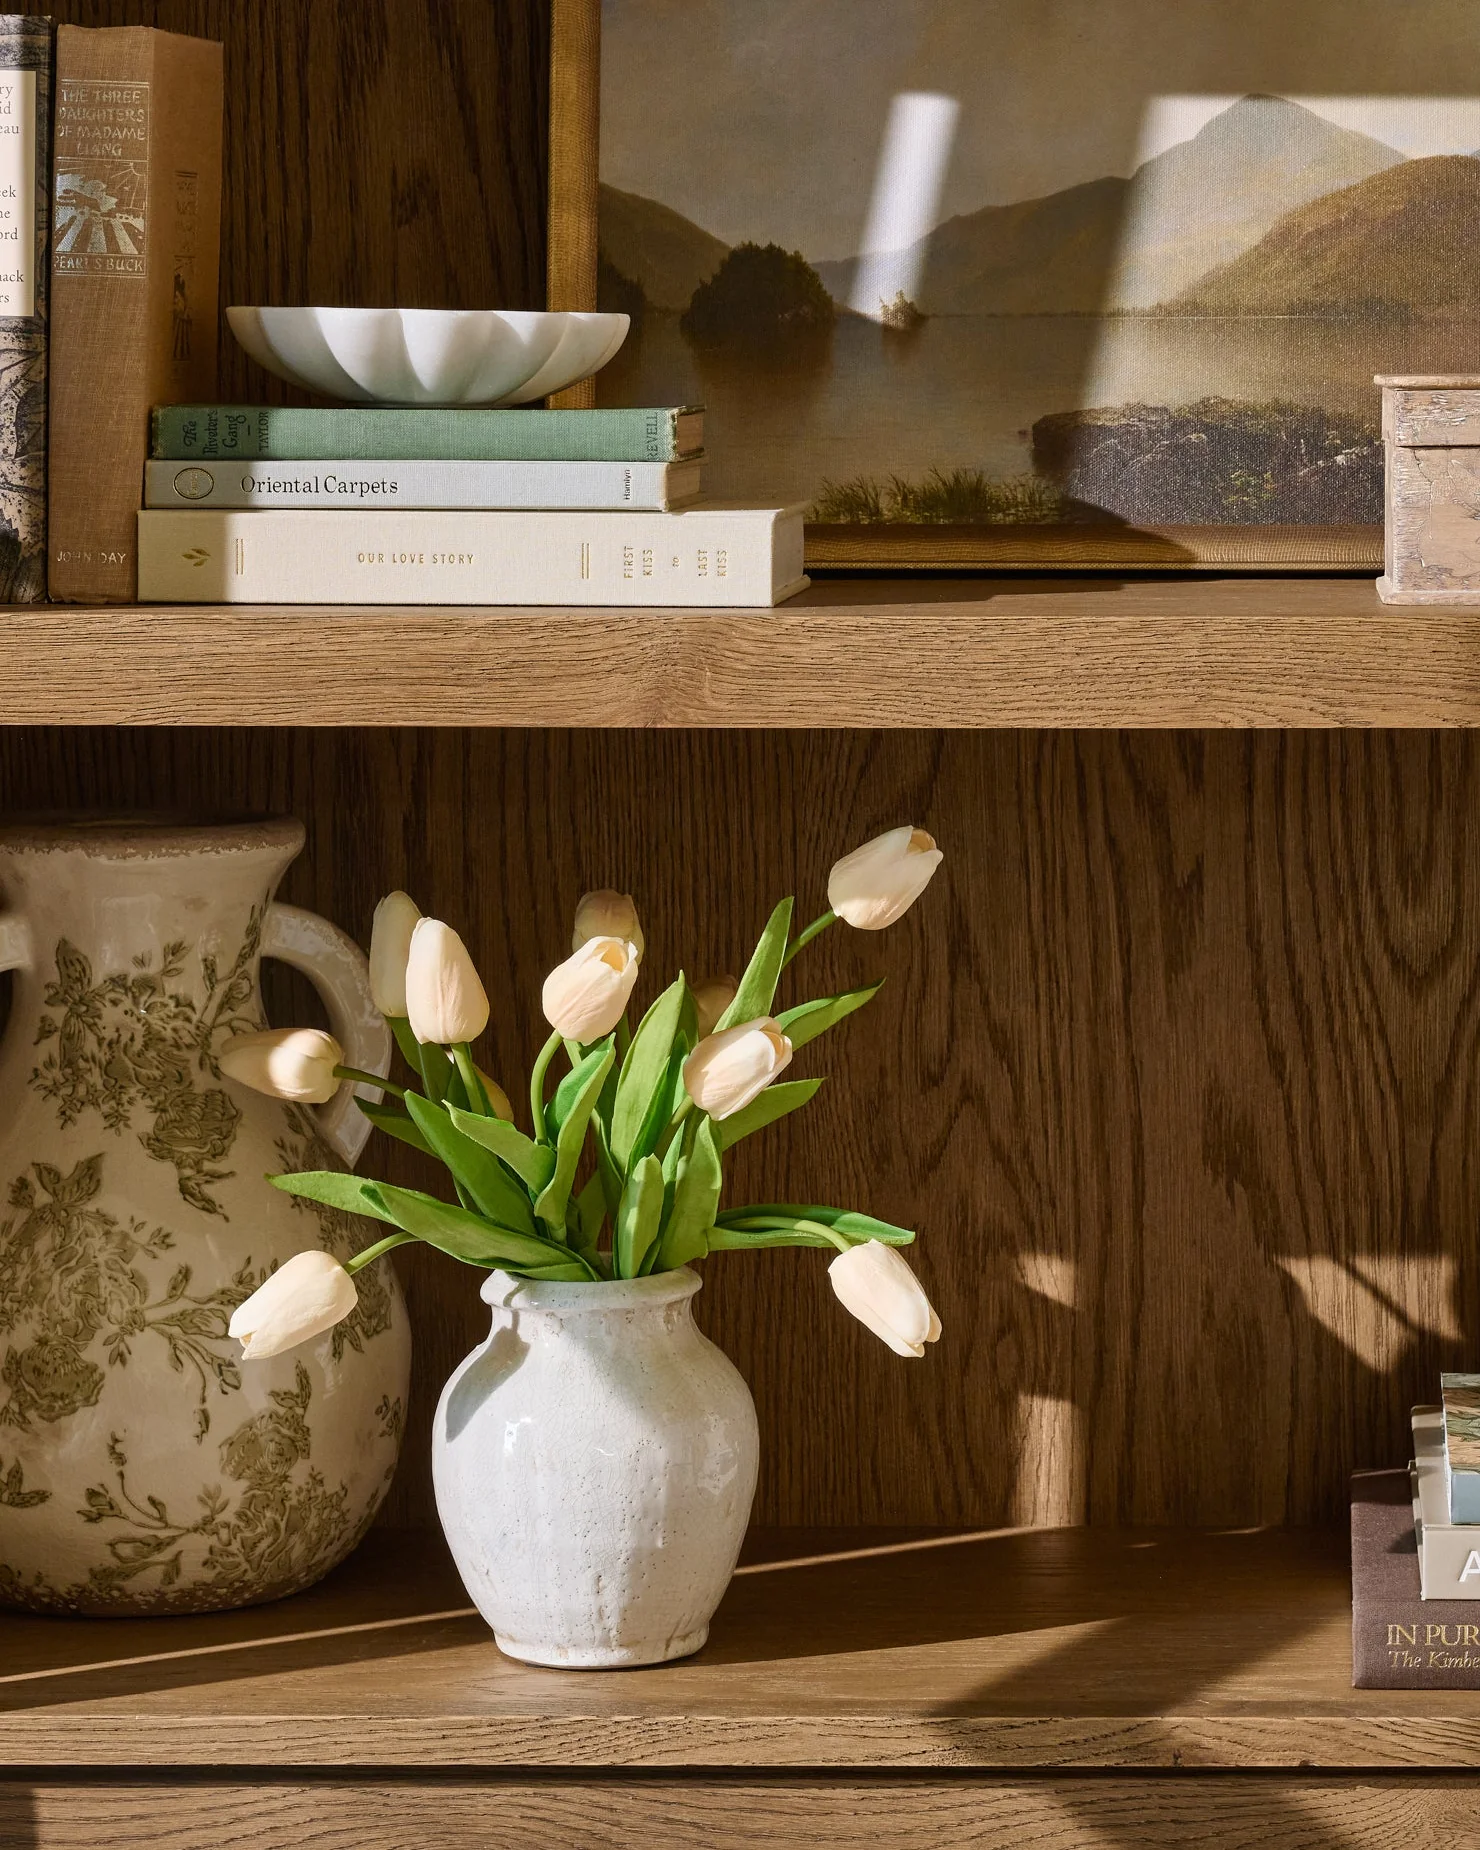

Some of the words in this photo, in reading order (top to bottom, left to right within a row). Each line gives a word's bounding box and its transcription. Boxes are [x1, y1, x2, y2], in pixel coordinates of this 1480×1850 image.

[62, 89, 87, 102] THE
[93, 90, 141, 104] THREE
[59, 107, 145, 122] DAUGHTERS
[77, 126, 146, 140] MADAME
[94, 258, 103, 270] S
[106, 259, 143, 272] BUCK
[182, 420, 198, 447] The
[222, 414, 247, 449] Gang
[258, 411, 270, 452] TAYLOR
[646, 411, 659, 460] REVELL
[241, 475, 320, 493] Oriental
[324, 475, 398, 497] Carpets
[623, 468, 633, 500] Hamlyn
[56, 551, 92, 563] JOHN
[98, 552, 127, 564] DAY
[357, 553, 385, 563] OUR
[392, 553, 424, 564] LOVE
[432, 554, 474, 564] STORY
[623, 545, 634, 579] FIRST
[642, 548, 653, 577] KISS
[697, 549, 708, 577] LAST
[717, 549, 727, 577] KISS
[1386, 1624, 1419, 1646] IN
[1424, 1624, 1480, 1646] PUR
[1387, 1650, 1422, 1668] The
[1426, 1650, 1480, 1669] Kimbe
